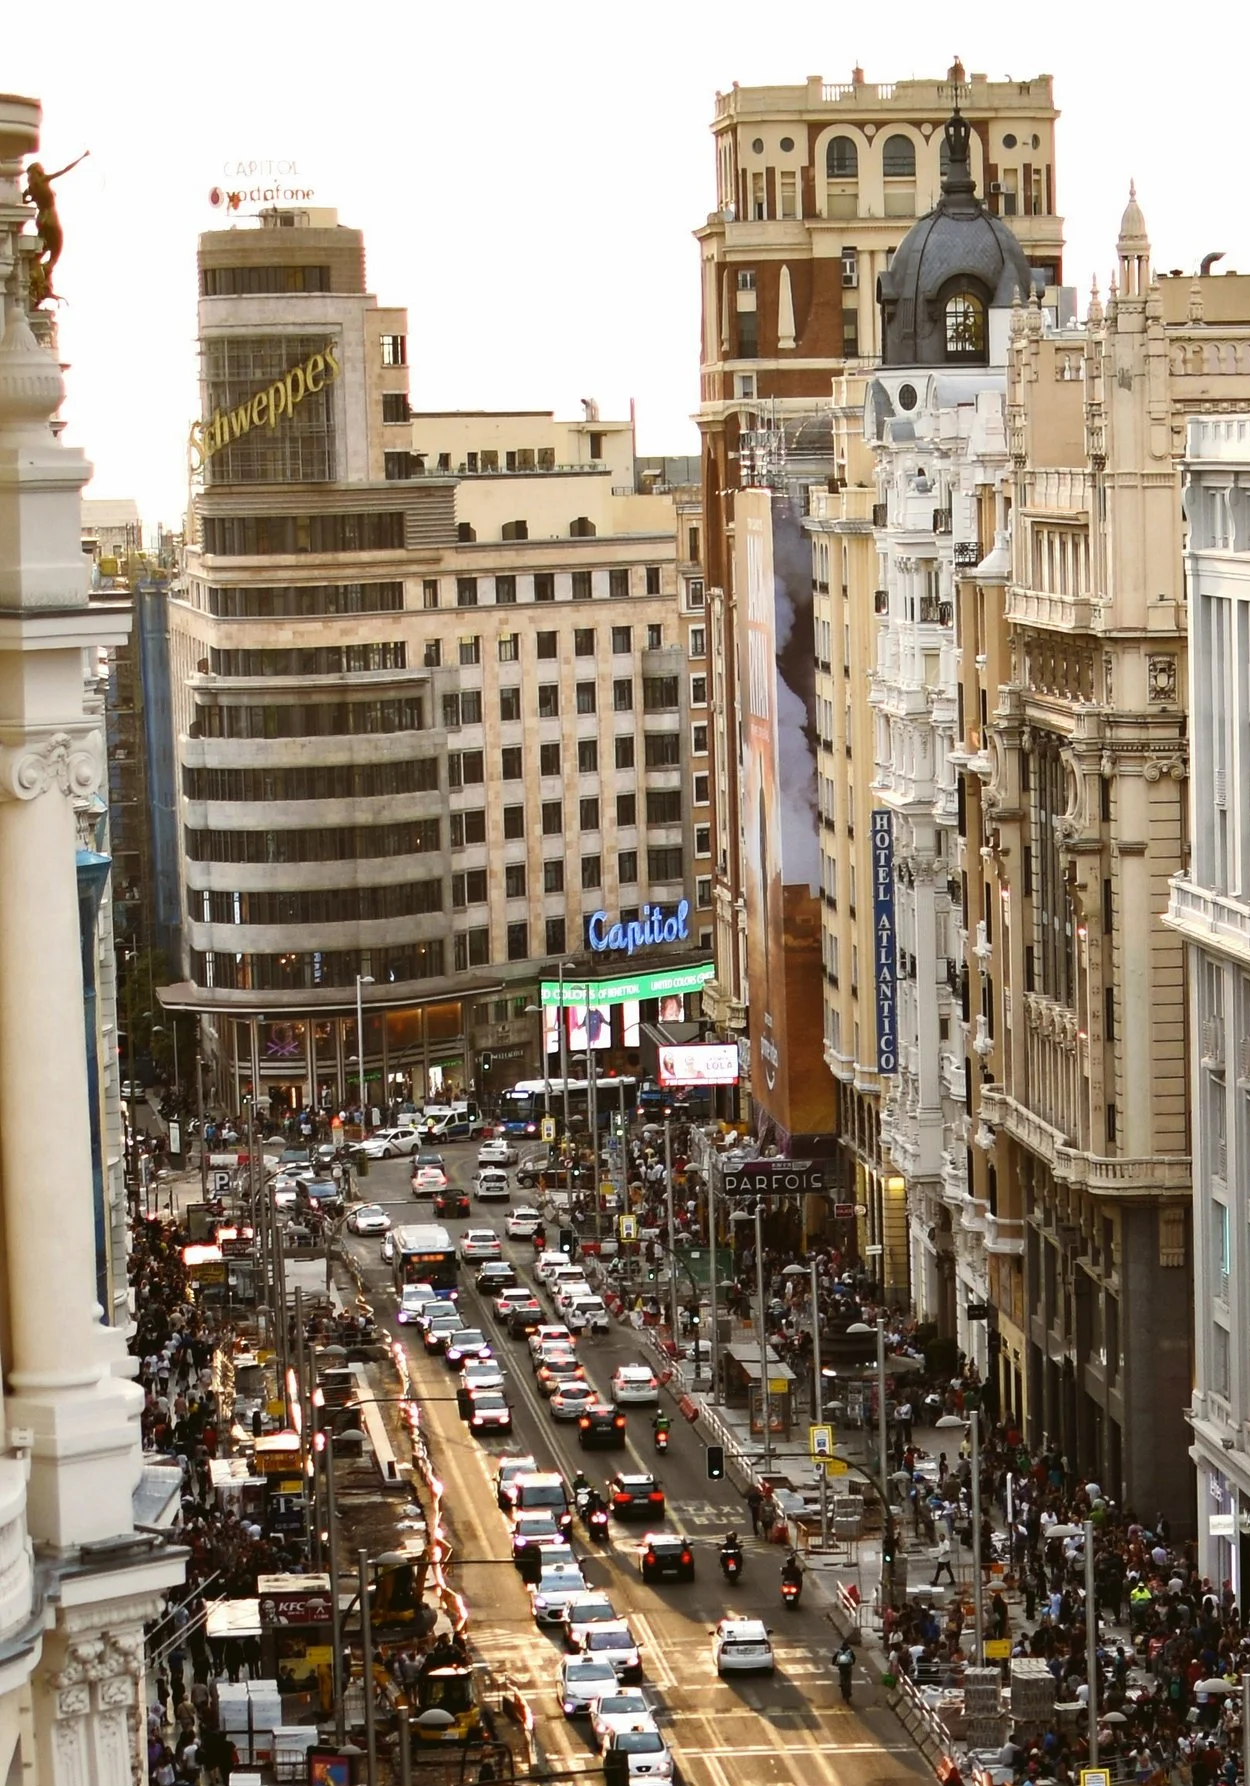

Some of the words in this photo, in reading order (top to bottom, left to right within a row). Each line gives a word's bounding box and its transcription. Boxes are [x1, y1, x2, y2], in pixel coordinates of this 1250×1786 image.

[223, 160, 300, 176] CAPITOL
[226, 185, 315, 201] vodafone
[187, 340, 341, 472] Schweppes
[874, 814, 891, 900] HOTEL
[589, 899, 689, 955] Capitol
[877, 913, 895, 1070] ATLANTICO
[216, 1173, 229, 1190] P
[725, 1173, 822, 1191] PARFOIS
[279, 1602, 306, 1611] KFC
